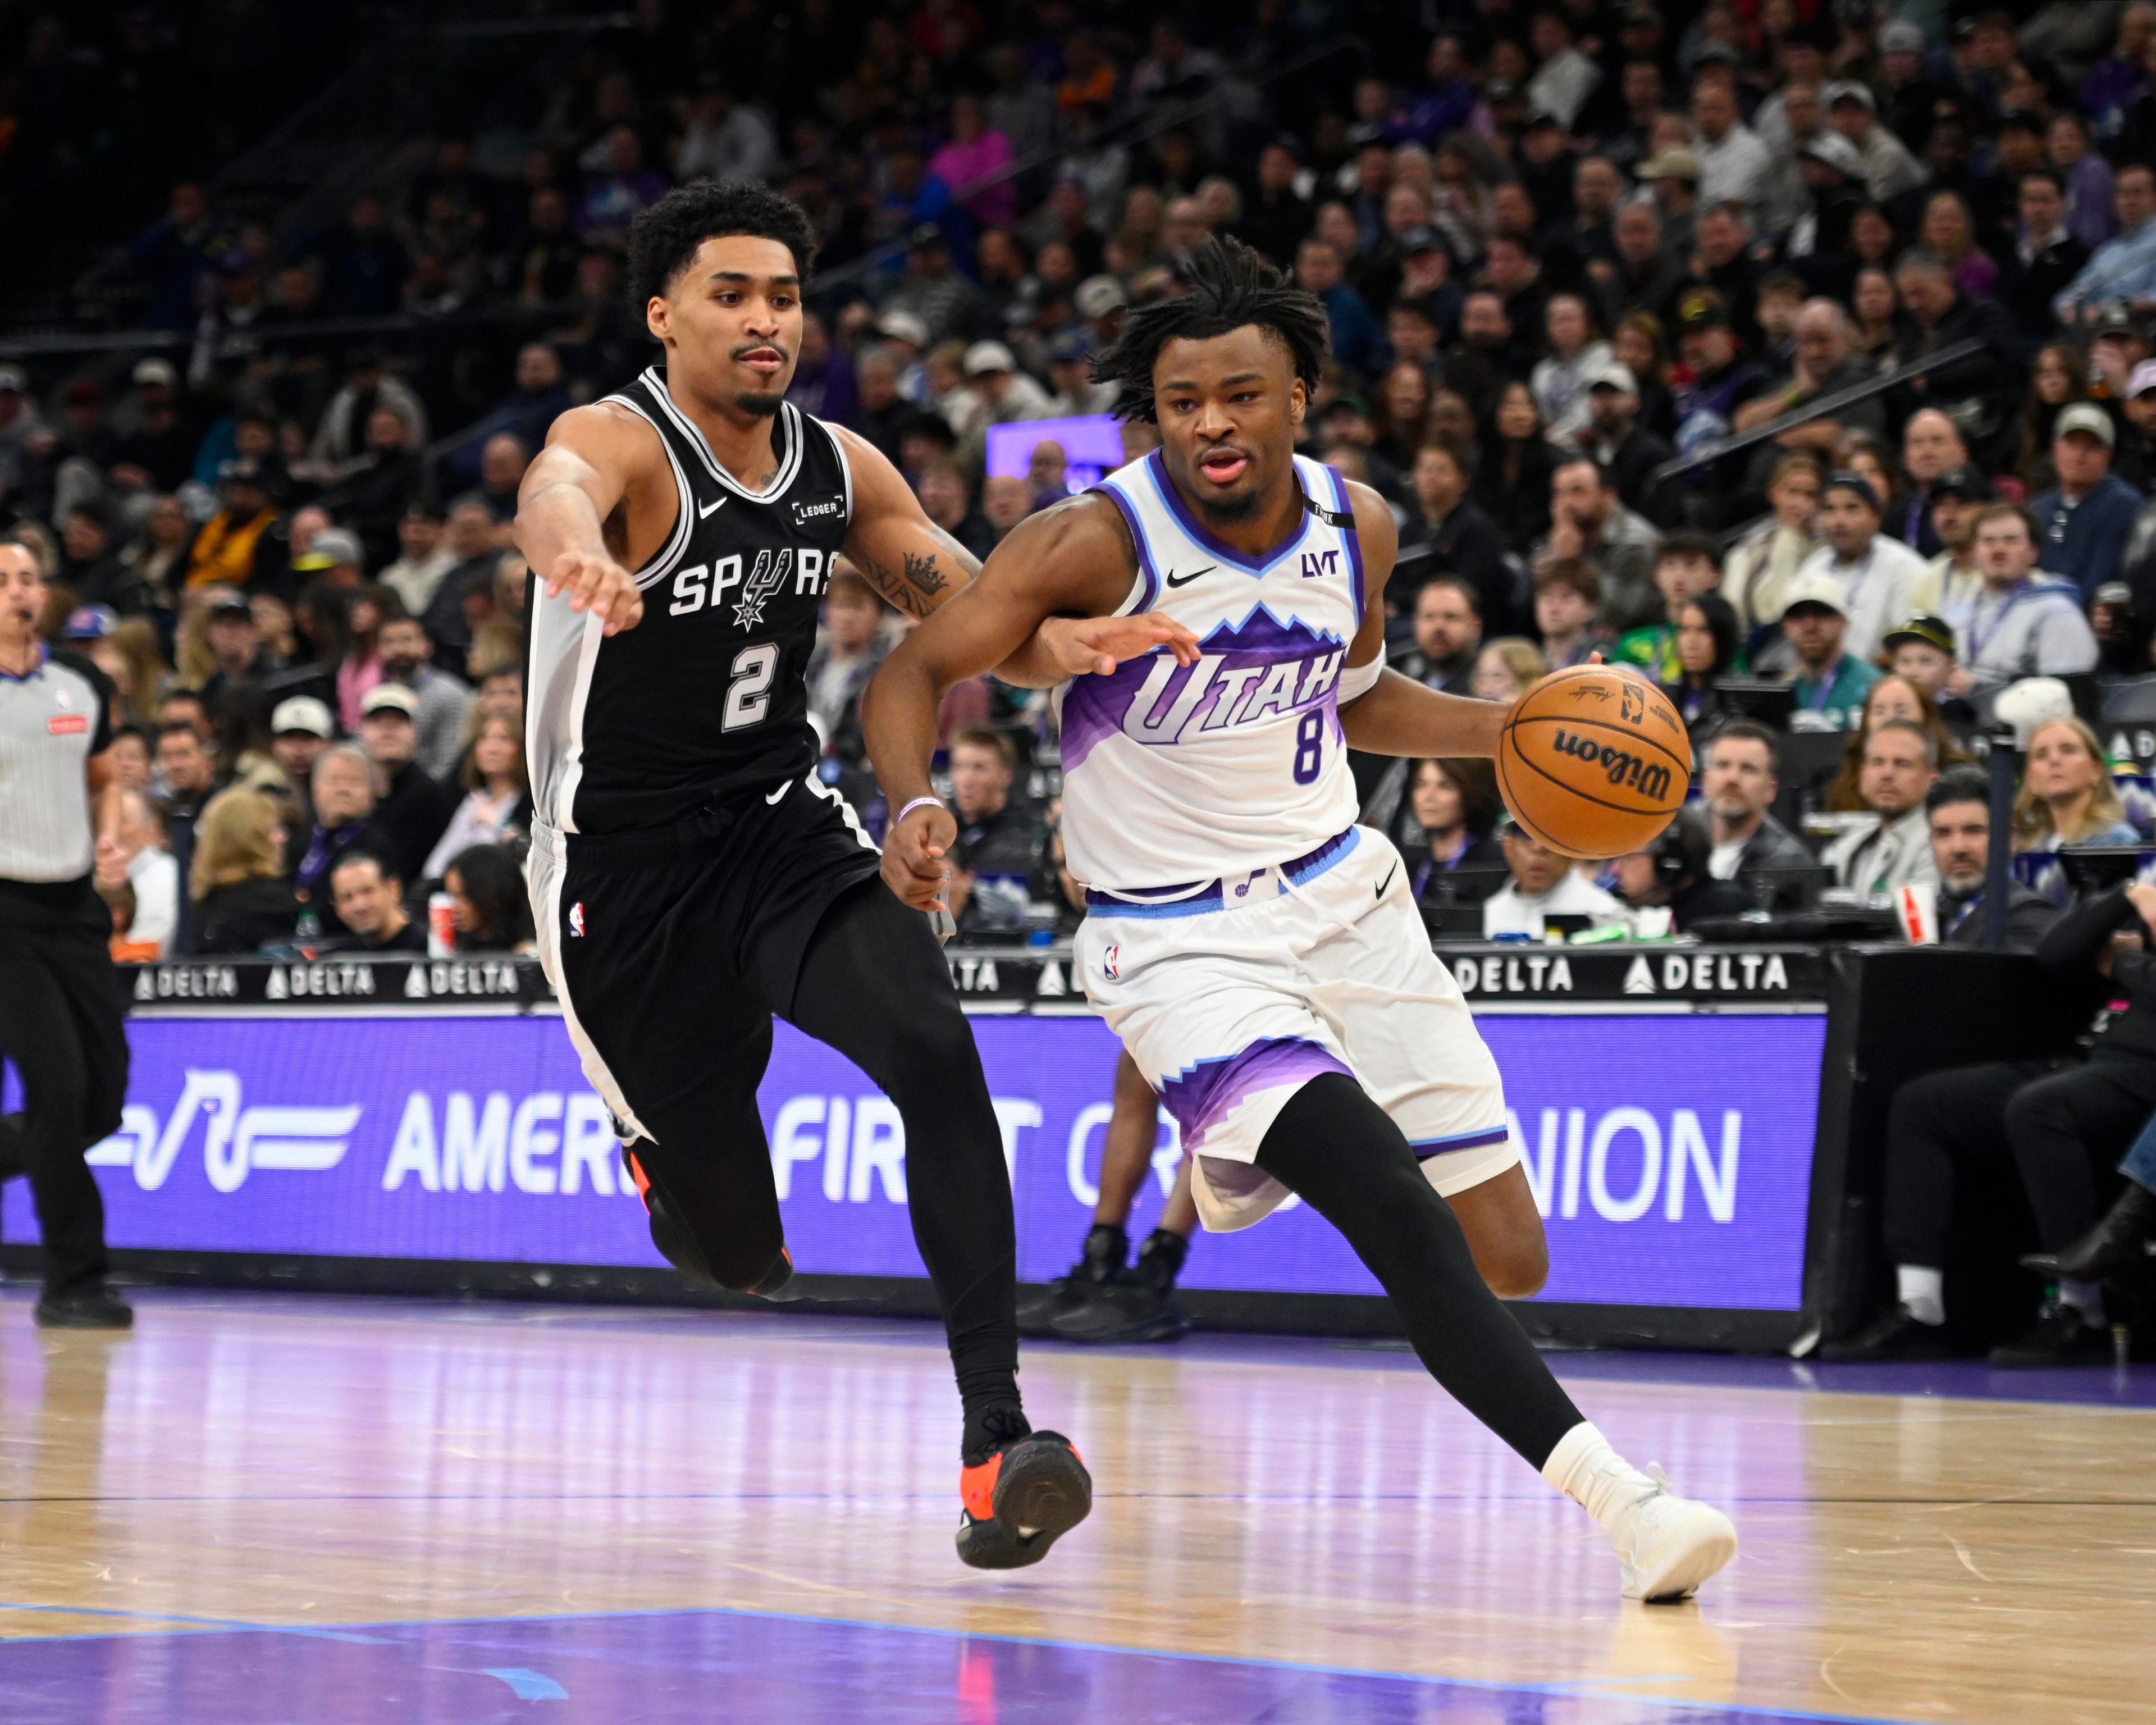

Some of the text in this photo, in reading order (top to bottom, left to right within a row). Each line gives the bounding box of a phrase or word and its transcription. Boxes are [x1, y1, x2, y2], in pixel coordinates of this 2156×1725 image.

[800, 503, 837, 518] LEDGER
[1301, 550, 1340, 578] LVT
[721, 642, 779, 733] 2
[1123, 646, 1347, 745] UTAH
[1292, 707, 1324, 787] 8
[1552, 728, 1671, 802] Wilson
[156, 965, 239, 998] DELTA
[289, 963, 376, 996] DELTA
[430, 961, 520, 995] DELTA
[1454, 956, 1573, 993] DELTA
[1663, 955, 1789, 991] DELTA
[381, 1090, 639, 1197] AMER
[771, 1094, 1044, 1206] FIRT
[1505, 1106, 1742, 1224] NION
